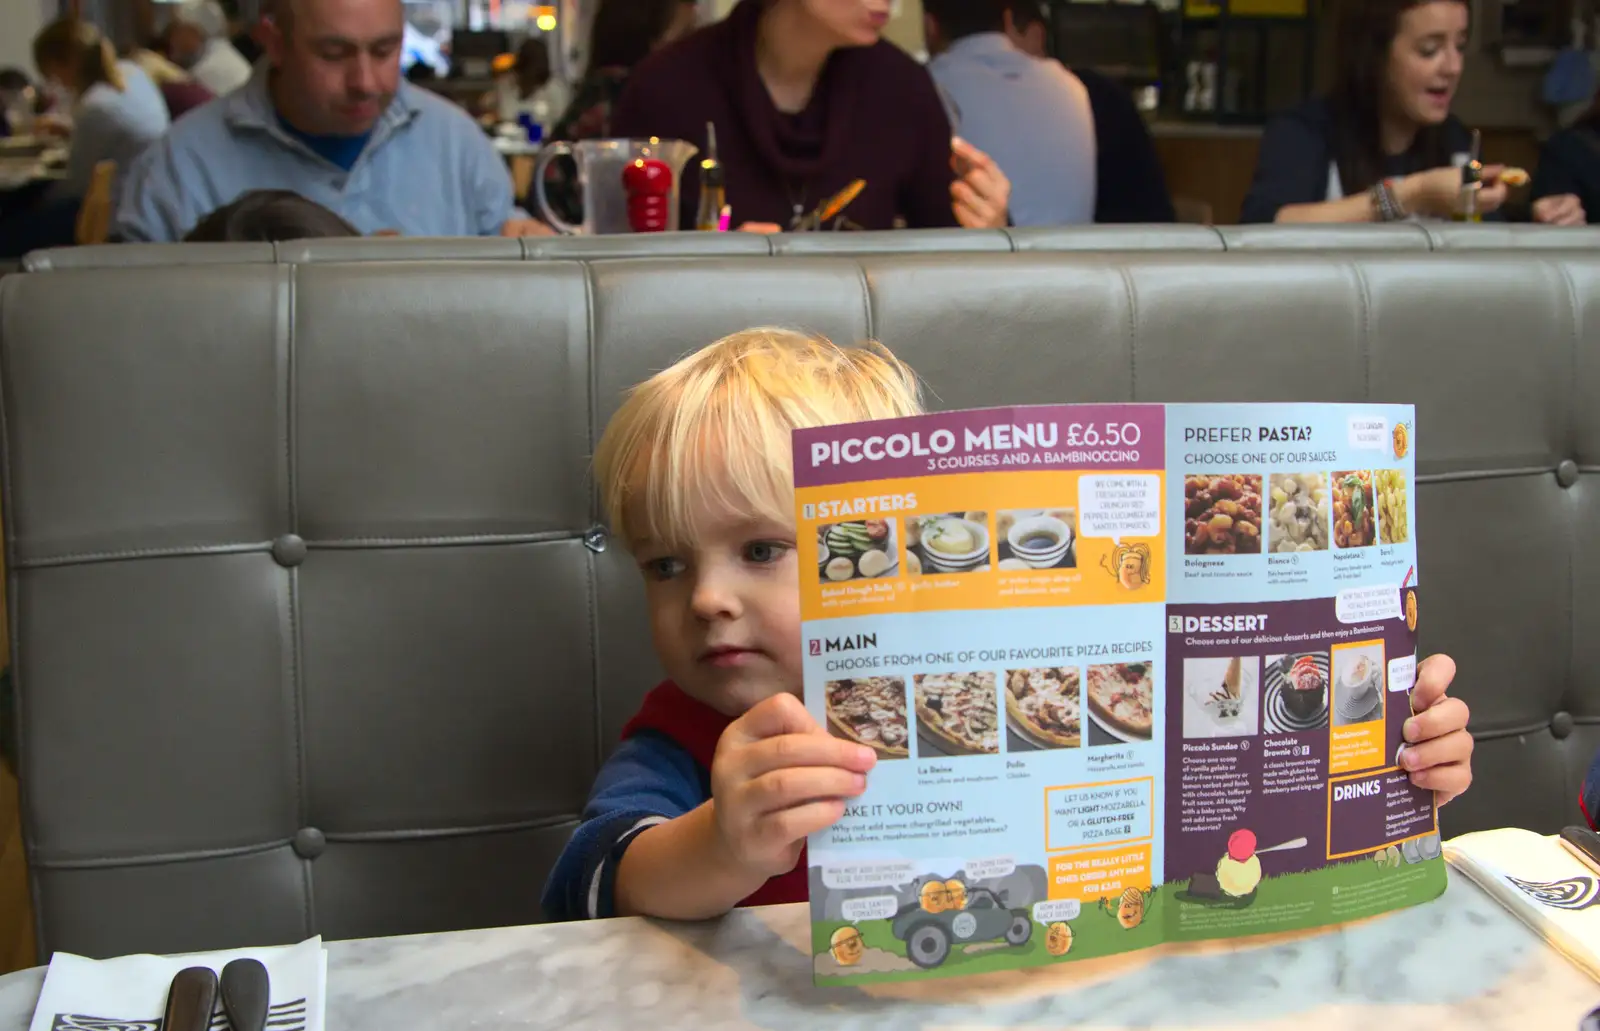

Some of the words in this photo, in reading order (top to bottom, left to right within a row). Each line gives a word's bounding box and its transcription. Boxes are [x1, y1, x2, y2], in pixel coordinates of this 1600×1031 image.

[1185, 427, 1251, 442] PREFER
[1259, 426, 1312, 441] PASTA?
[811, 429, 955, 467] PICCOLO
[964, 422, 1058, 452] MENU
[1066, 422, 1141, 446] £6.50
[927, 458, 936, 470] 3
[937, 453, 1000, 469] COURSES
[1002, 452, 1030, 465] AND
[1032, 452, 1042, 464] A
[1044, 450, 1140, 464] BAMBINOCCINO
[1184, 453, 1239, 464] CHOOSE
[1242, 452, 1267, 464] ONE
[1269, 452, 1285, 463] OF
[1287, 452, 1307, 463] OUR
[1309, 450, 1337, 462] SAUCES
[818, 493, 917, 518] STARTERS
[1184, 559, 1225, 568] Bolognese
[1185, 614, 1268, 633] DESSERT
[825, 632, 877, 652] MAIN
[1185, 637, 1214, 646] Choose
[1216, 637, 1230, 645] one
[1231, 636, 1239, 645] of
[1240, 637, 1252, 645] our
[1253, 635, 1282, 643] delicious
[1283, 632, 1309, 641] desserts
[1310, 630, 1320, 639] and
[1335, 630, 1349, 638] enjoy
[826, 656, 880, 671] CHOOSE
[884, 653, 922, 666] FROM
[925, 652, 954, 664] ONE
[957, 651, 976, 663] OF
[978, 649, 1006, 662] OUR
[1009, 646, 1074, 660] FAVOURITE
[1076, 644, 1109, 658] PIZZA
[1111, 641, 1153, 654] RECIPES
[1183, 743, 1210, 752] Piccolo
[1211, 742, 1238, 751] Sundae
[1264, 738, 1298, 747] Chocolate
[1088, 752, 1124, 763] Margherita
[1264, 749, 1291, 757] Brownie
[1064, 795, 1077, 803] LET
[1079, 793, 1089, 801] US
[1090, 791, 1113, 800] KNOW
[1123, 788, 1138, 796] YOU
[1334, 780, 1380, 801] DRINKS
[843, 805, 868, 817] AKE
[872, 805, 883, 816] IT
[887, 803, 924, 815] YOUR
[927, 800, 963, 813] OWN!
[1054, 807, 1077, 816] WANT
[1078, 805, 1101, 814] LIGHT
[1101, 799, 1145, 811] MOZZARELLA
[1067, 820, 1079, 828] OR
[1083, 830, 1103, 840] PIZZA
[1105, 827, 1122, 837] BASE
[1056, 863, 1073, 872] FOR
[1074, 860, 1090, 869] THE
